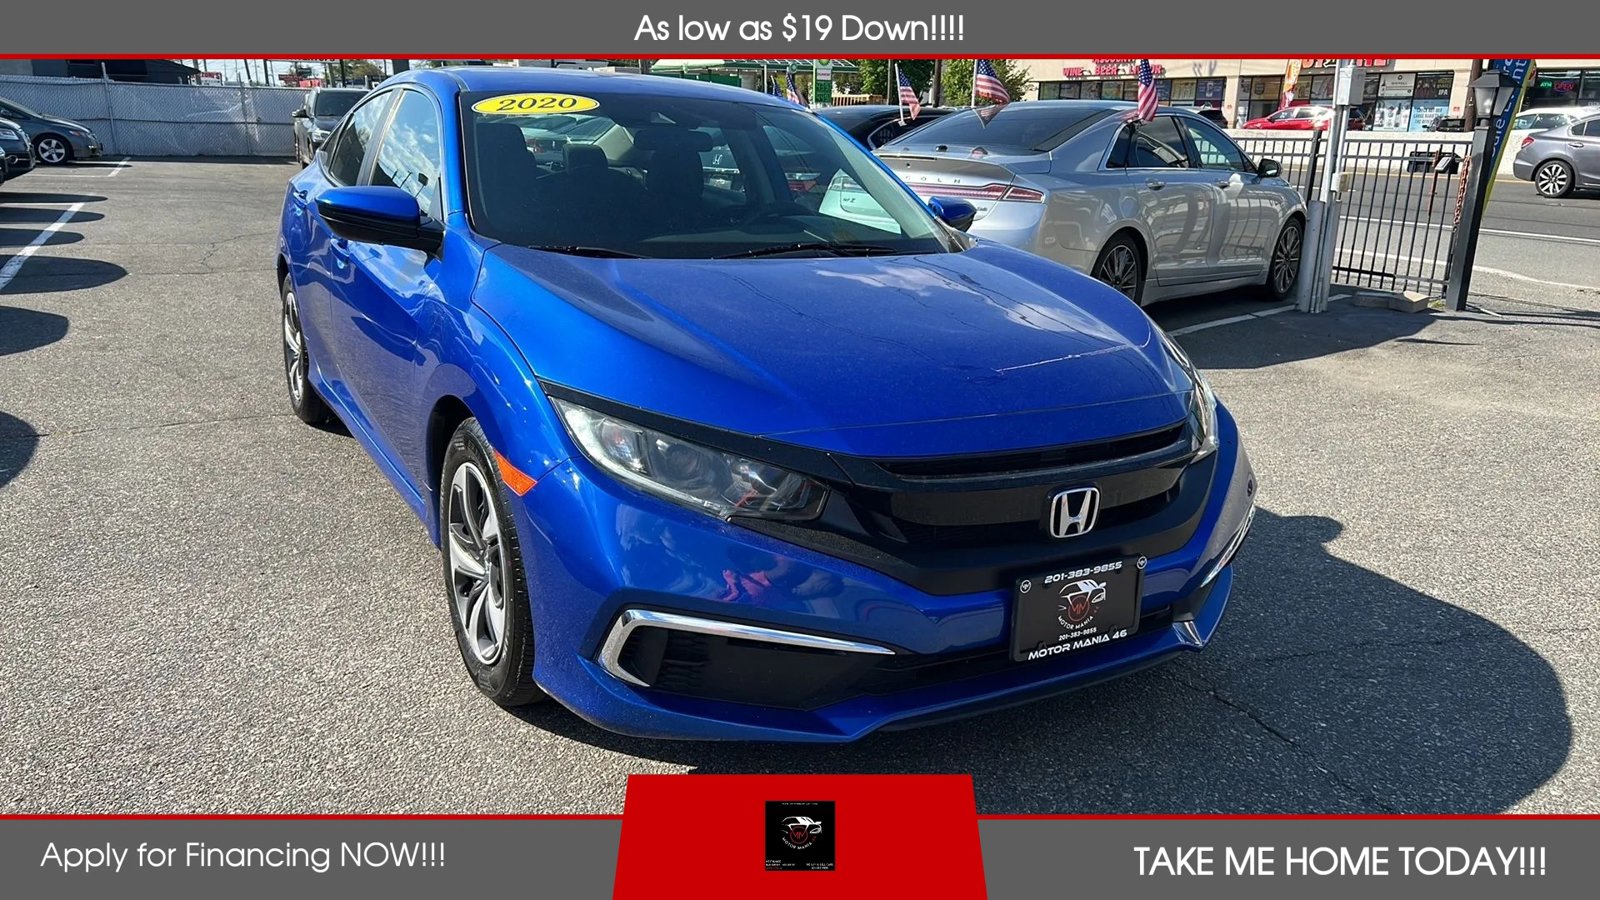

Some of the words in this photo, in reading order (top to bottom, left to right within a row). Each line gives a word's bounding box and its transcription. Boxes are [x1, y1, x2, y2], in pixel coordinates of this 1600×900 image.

[1094, 64, 1118, 76] BEER
[1554, 82, 1575, 90] OPEN
[496, 97, 578, 112] 2020
[1044, 561, 1122, 584] 201-383-9855
[1058, 615, 1075, 630] MOTOR
[1075, 615, 1094, 630] MANIA
[1028, 642, 1071, 661] MOTOR
[1072, 633, 1110, 650] MANIA
[1112, 629, 1128, 640] 46
